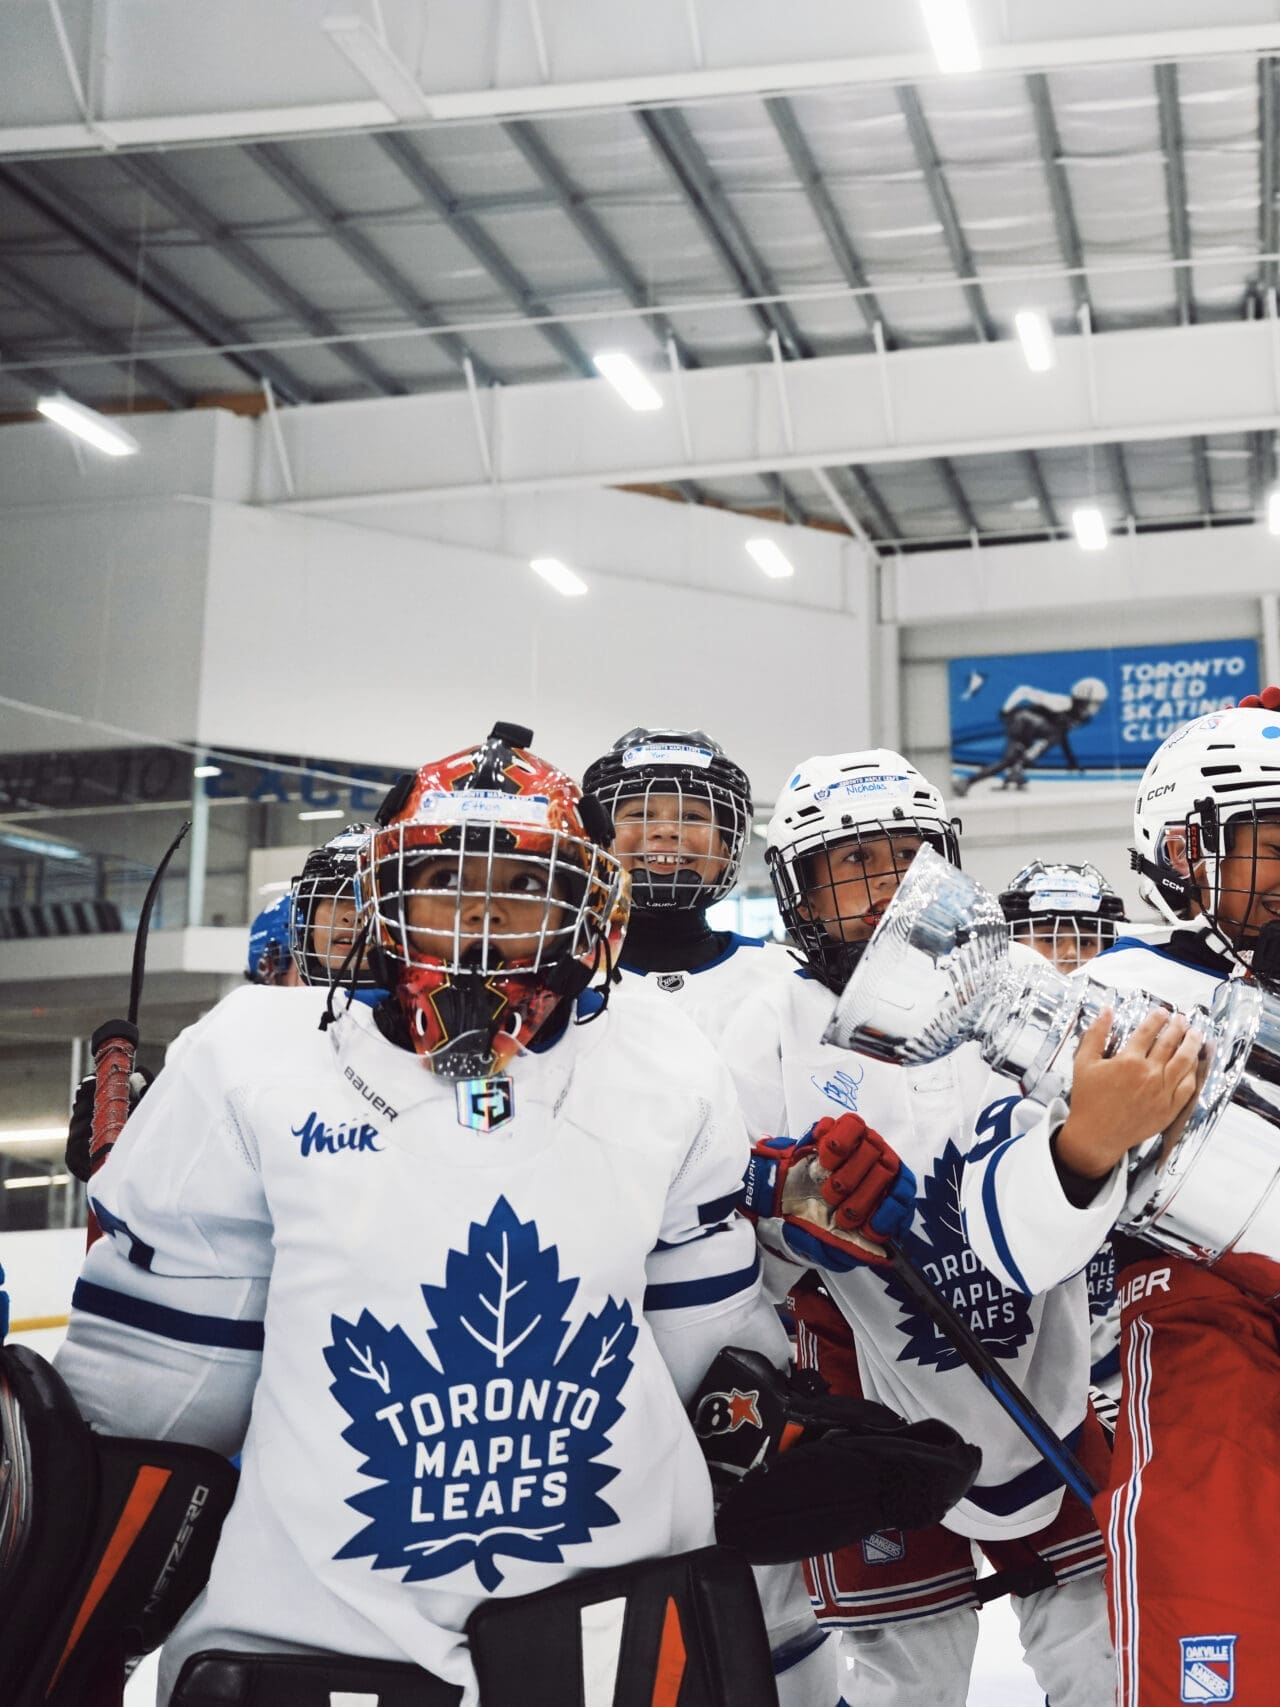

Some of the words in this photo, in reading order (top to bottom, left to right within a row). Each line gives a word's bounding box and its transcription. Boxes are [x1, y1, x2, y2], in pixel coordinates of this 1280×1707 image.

[1121, 656, 1245, 682] TORONTO
[1121, 679, 1207, 702] SPEED
[846, 783, 887, 795] Nicholas
[1147, 782, 1176, 801] CCM
[1162, 878, 1185, 893] CCM
[343, 1066, 399, 1123] BAUER
[1090, 1259, 1116, 1278] PLE
[1087, 1276, 1114, 1296] AFS
[375, 1378, 600, 1446] TORONTO
[414, 1427, 571, 1479] MAPLE
[411, 1471, 568, 1523] LEAFS
[1185, 1645, 1229, 1659] OAKVILLE
